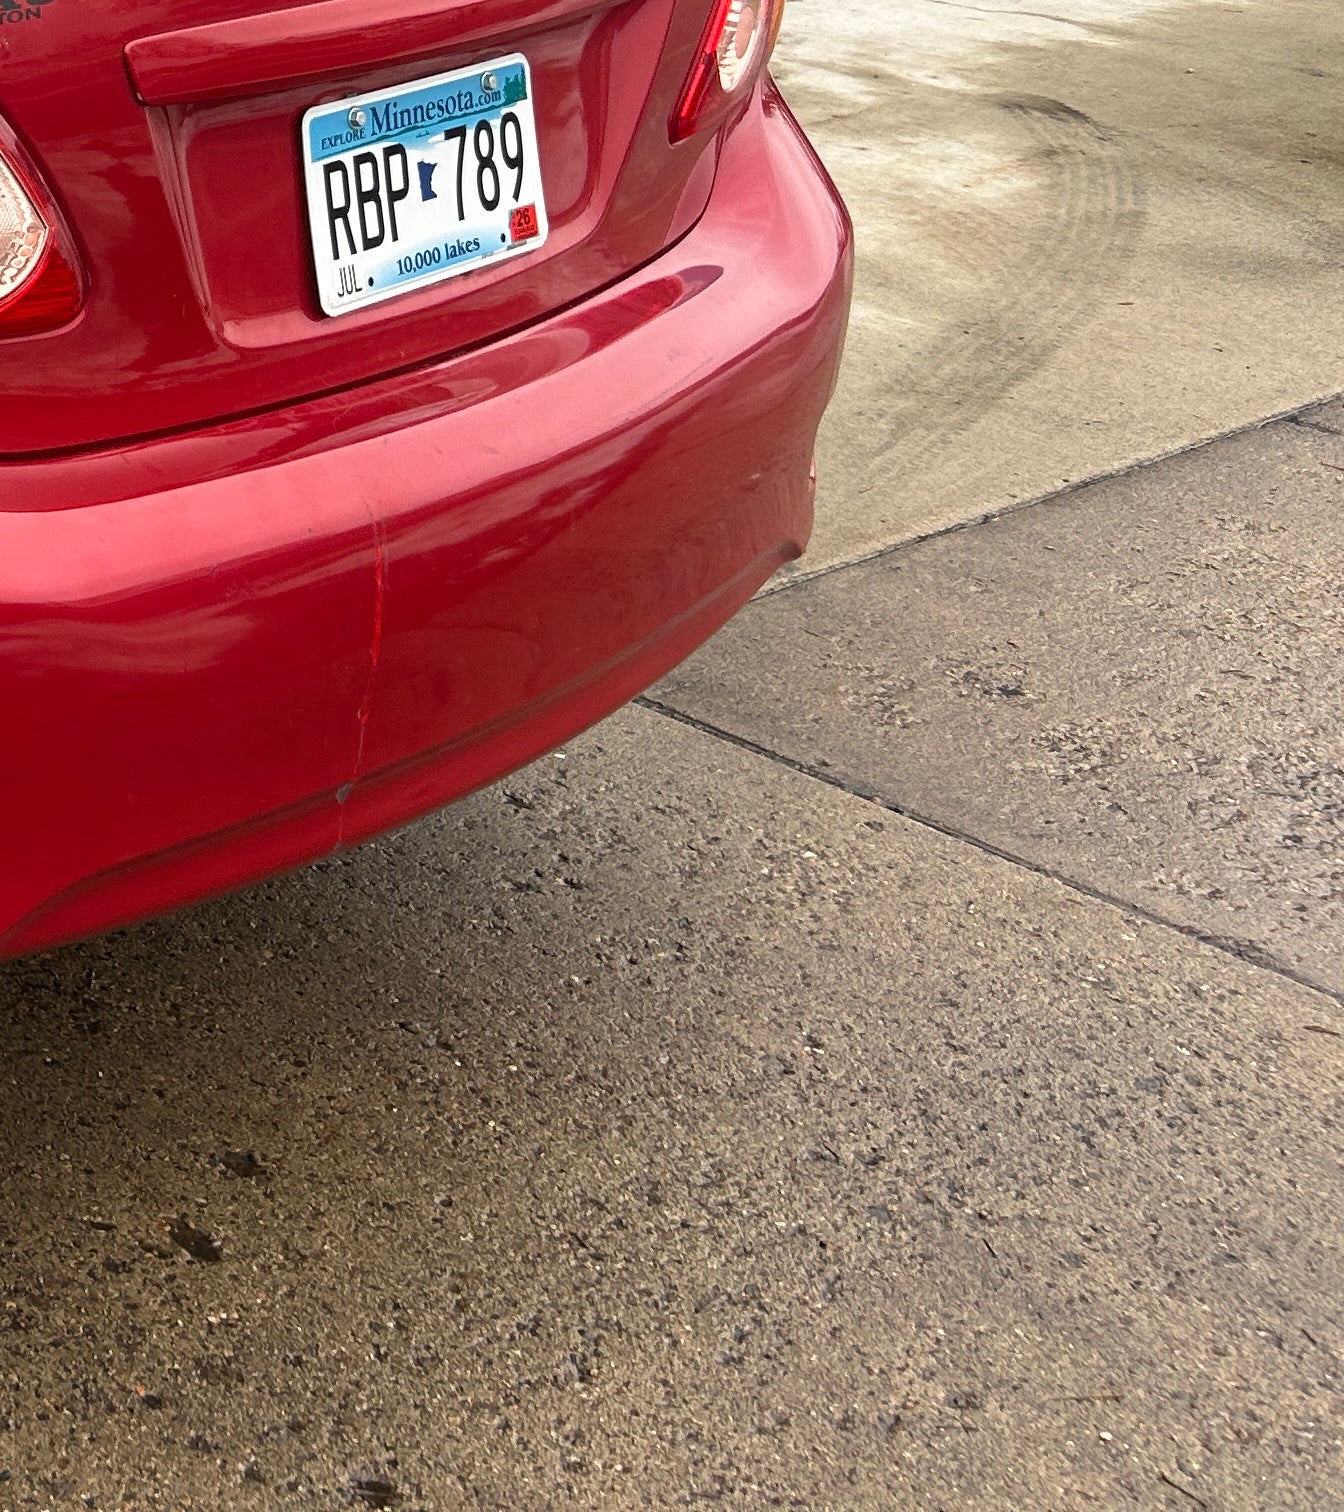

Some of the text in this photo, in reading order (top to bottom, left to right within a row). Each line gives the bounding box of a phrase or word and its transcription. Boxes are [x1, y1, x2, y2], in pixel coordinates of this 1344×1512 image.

[321, 128, 366, 150] EXPLORE
[323, 111, 525, 260] RBP 789
[515, 207, 531, 227] 26
[396, 237, 481, 276] 10,000 lakes
[337, 265, 363, 298] JUL
